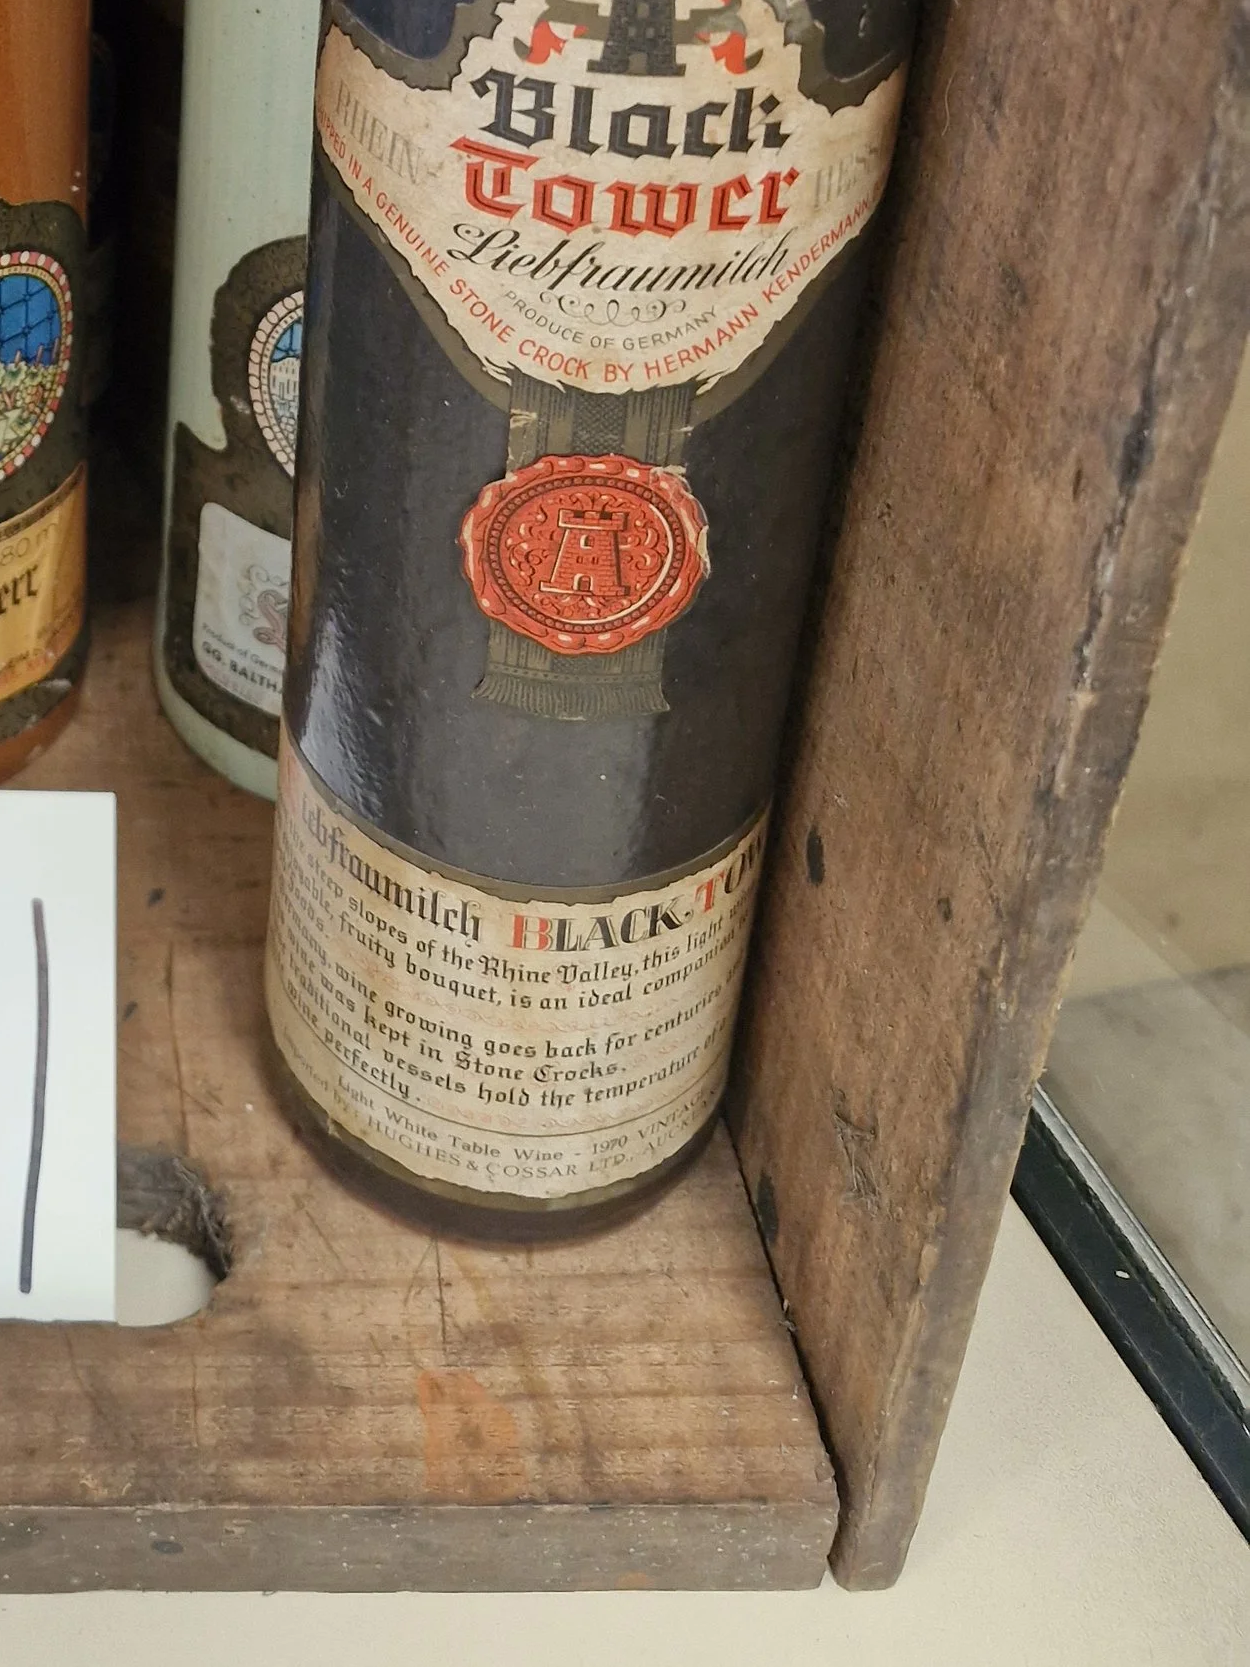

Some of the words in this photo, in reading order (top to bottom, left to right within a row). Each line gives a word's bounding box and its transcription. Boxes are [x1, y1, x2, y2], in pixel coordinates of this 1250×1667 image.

[450, 135, 802, 238] Tower
[318, 105, 347, 160] HIPPED
[347, 153, 362, 181] IN
[361, 176, 374, 196] A
[375, 191, 451, 278] GENUINE
[449, 278, 520, 344] STONE
[518, 338, 593, 381] CROCK
[603, 361, 635, 383] BY
[643, 302, 760, 381] HERMANN
[761, 196, 871, 304] KENDERMANN
[446, 221, 800, 295] Liebfraumilch
[503, 289, 584, 344] PRODUCE
[589, 335, 616, 350] OF
[622, 304, 719, 352] GERMANY
[300, 792, 482, 948] iebfraumilch
[337, 911, 396, 968] fruity
[405, 952, 502, 1007] bouquet,
[510, 988, 532, 1010] is
[539, 995, 568, 1011] an
[578, 983, 632, 1009] ideal
[642, 928, 736, 995] companion
[348, 898, 408, 945] slopes
[415, 939, 437, 959] of
[441, 944, 475, 971] the
[477, 954, 551, 984] Rhine
[556, 960, 639, 985] Valley,
[643, 945, 681, 971] this
[686, 915, 724, 954] light
[320, 972, 357, 1014] was
[363, 1004, 412, 1048] kept
[419, 1038, 445, 1063] in
[454, 1049, 525, 1081] Stone
[533, 1060, 628, 1083] Crocks.
[334, 961, 379, 1004] wine
[384, 998, 473, 1050] growing
[483, 1038, 537, 1059] goes
[545, 1037, 598, 1059] back
[605, 1031, 640, 1056] for
[644, 984, 723, 1042] centuries
[324, 1027, 422, 1102] perfectly.
[383, 1048, 467, 1095] vessels
[477, 1081, 531, 1107] hold
[540, 1089, 577, 1110] the
[583, 1045, 702, 1105] temperature
[337, 1073, 375, 1109] Light
[384, 1104, 439, 1142] White
[447, 1133, 502, 1158] Table
[513, 1148, 565, 1162] Wine
[591, 1134, 628, 1156] 1970
[366, 1114, 462, 1167] HUGHES
[465, 1157, 480, 1172] &
[485, 1162, 579, 1180] COSSAR
